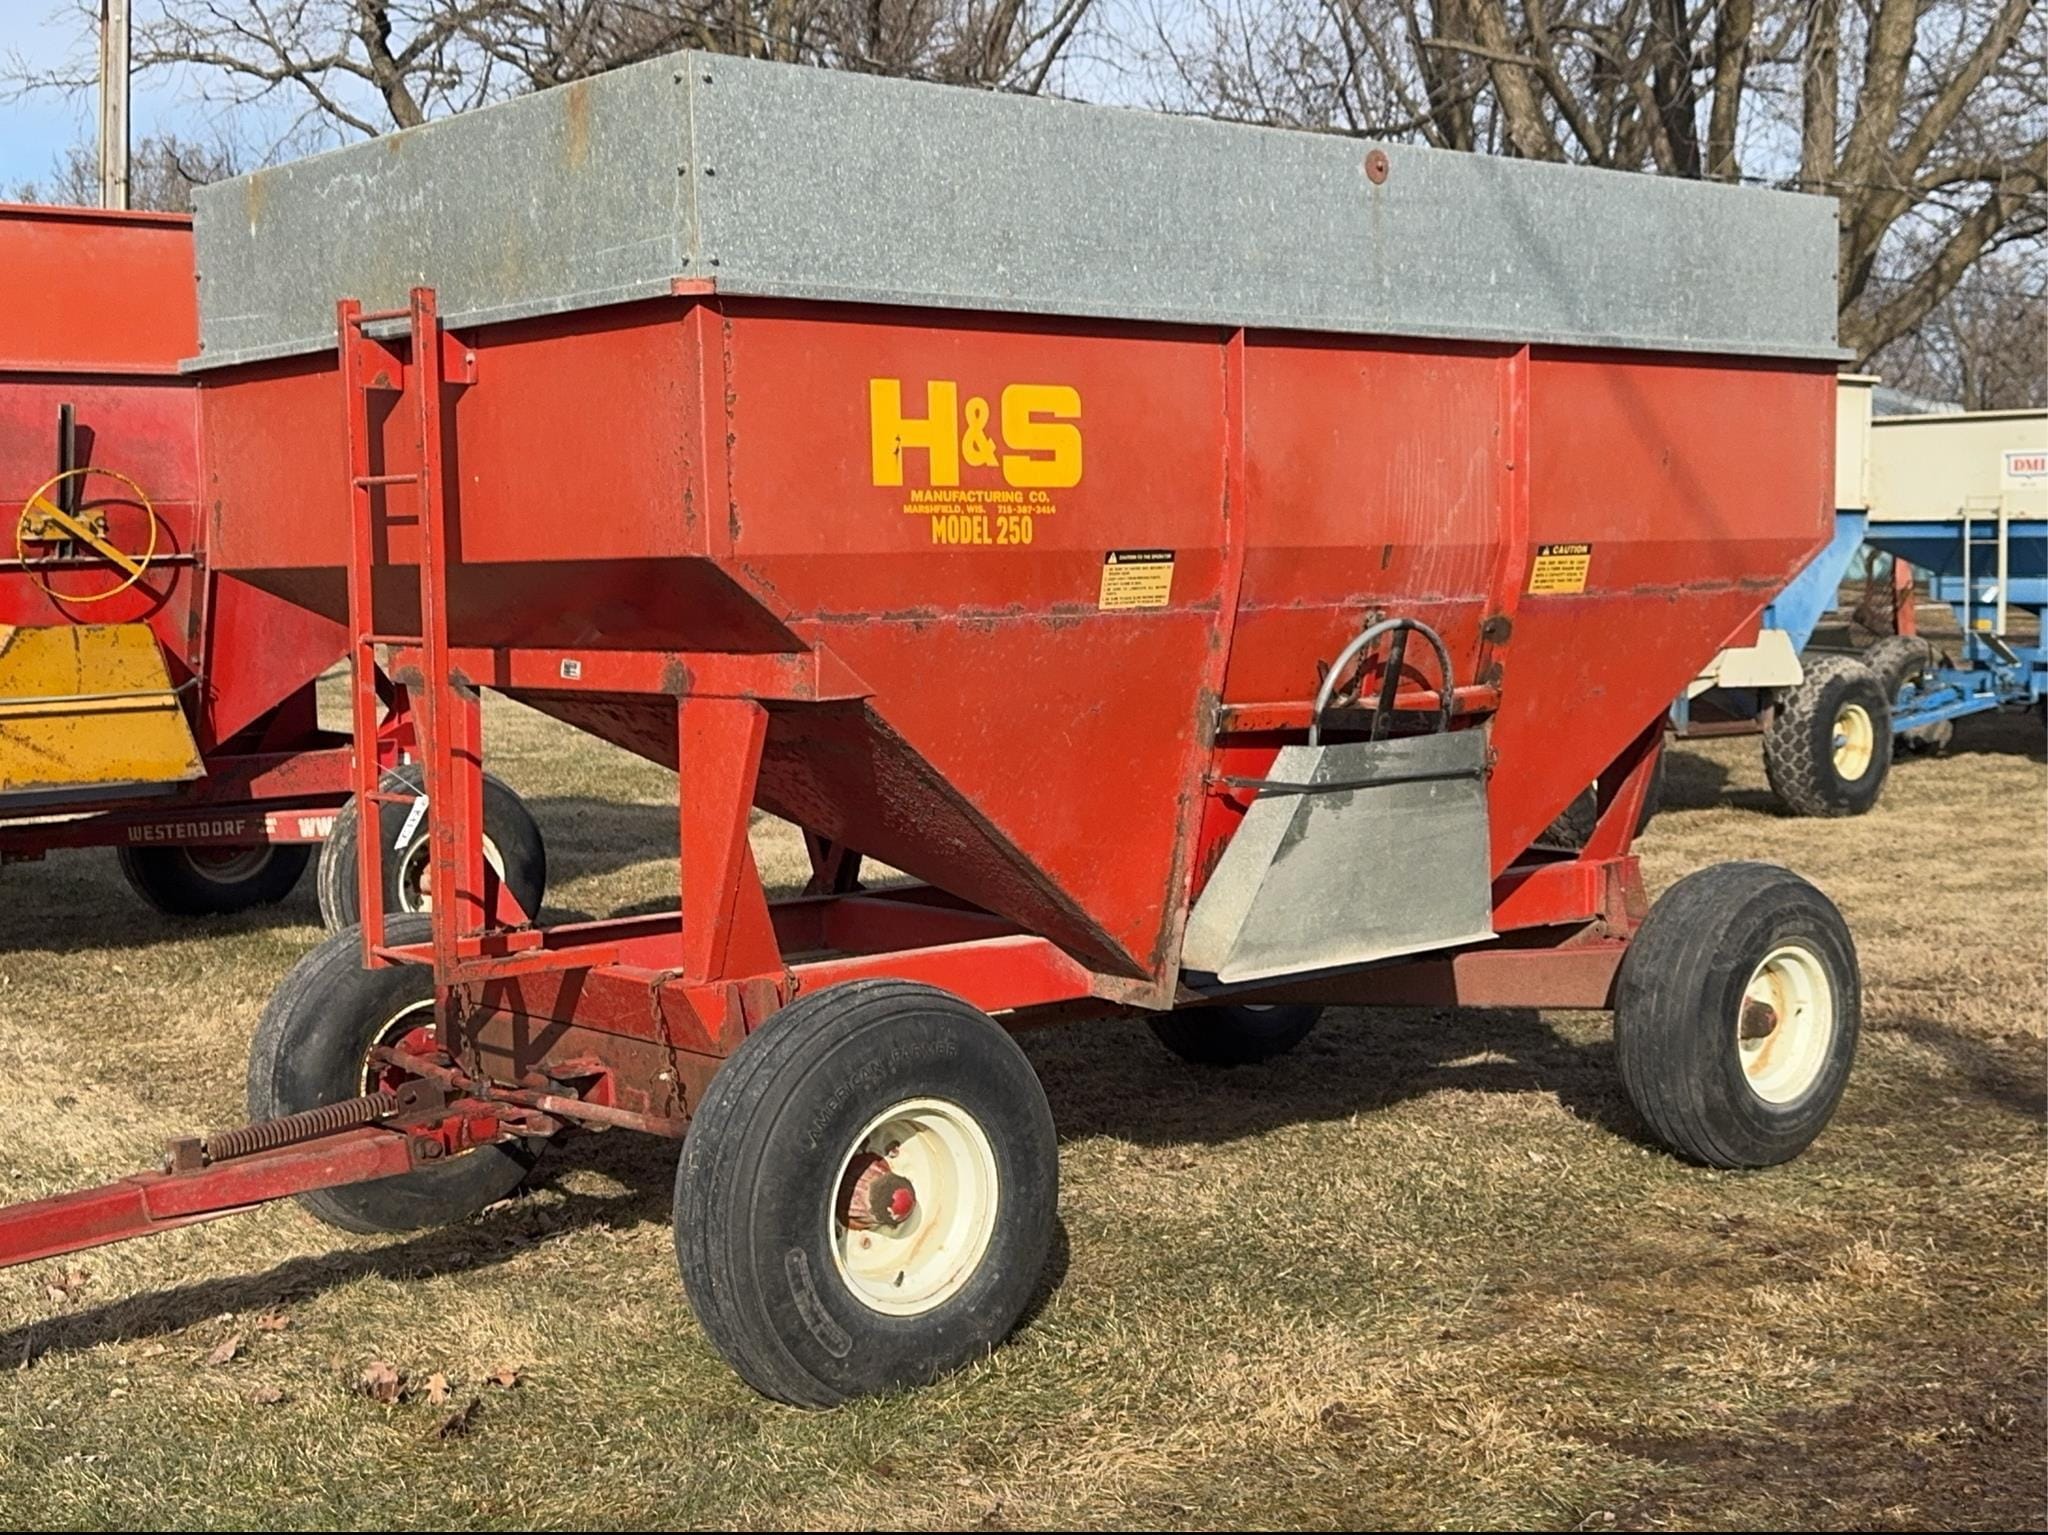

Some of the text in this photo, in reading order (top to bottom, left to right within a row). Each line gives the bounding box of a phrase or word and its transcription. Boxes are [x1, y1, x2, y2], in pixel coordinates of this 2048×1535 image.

[870, 378, 1083, 488] H&S
[2013, 458, 2045, 471] DMI
[910, 490, 1050, 503] MANUFACTURING CO.
[931, 515, 1033, 544] MODEL 250
[1552, 545, 1588, 554] CAUTION
[128, 819, 247, 841] WESTENDORF
[298, 816, 337, 838] WW
